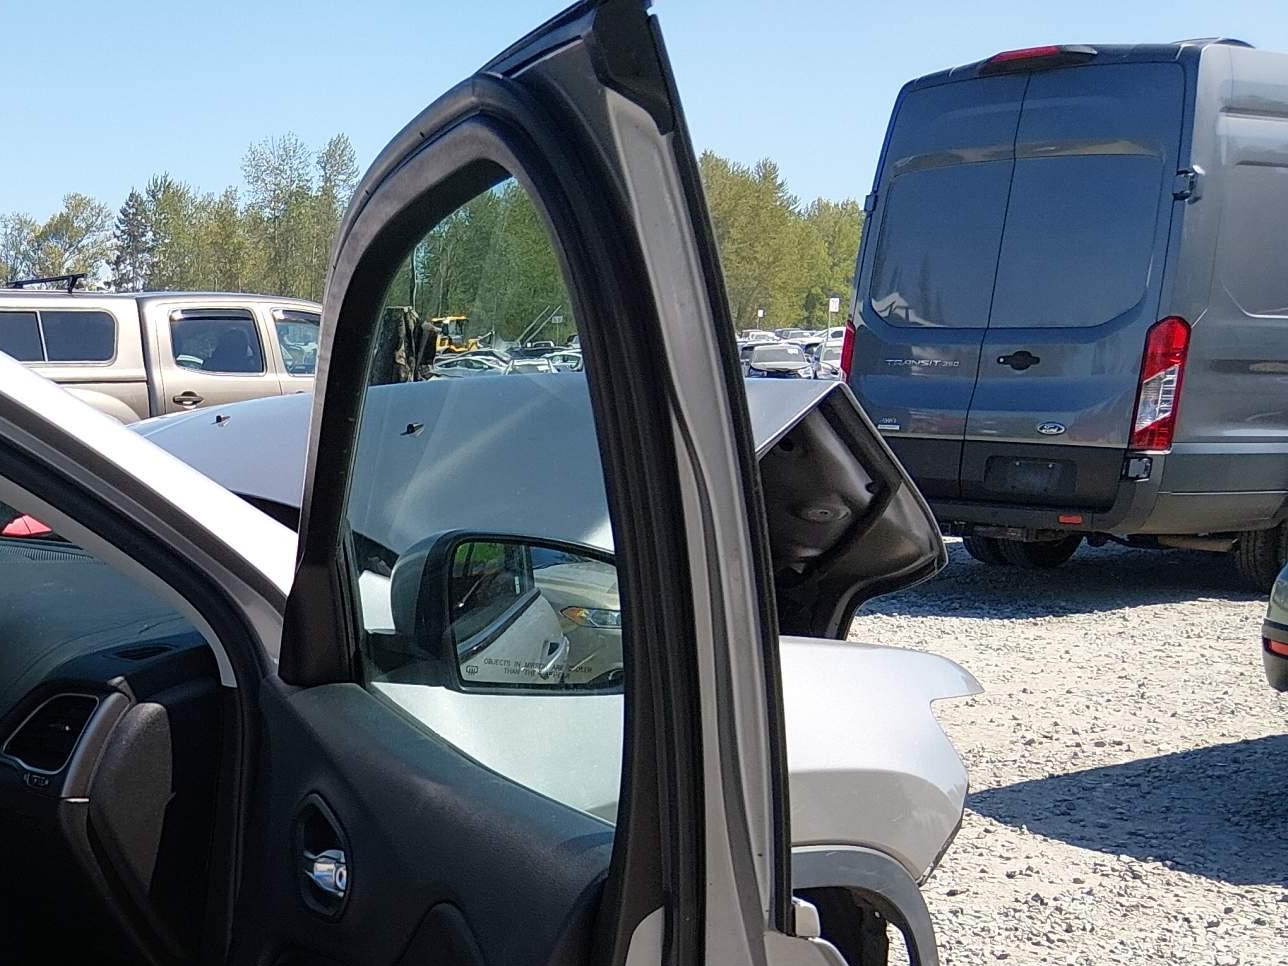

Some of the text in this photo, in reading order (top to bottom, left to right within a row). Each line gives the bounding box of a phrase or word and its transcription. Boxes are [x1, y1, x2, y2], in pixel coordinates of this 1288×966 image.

[885, 359, 941, 367] TRANSIT
[483, 657, 511, 667] OBJECTS
[513, 660, 521, 668] IN
[504, 667, 521, 675] THAN
